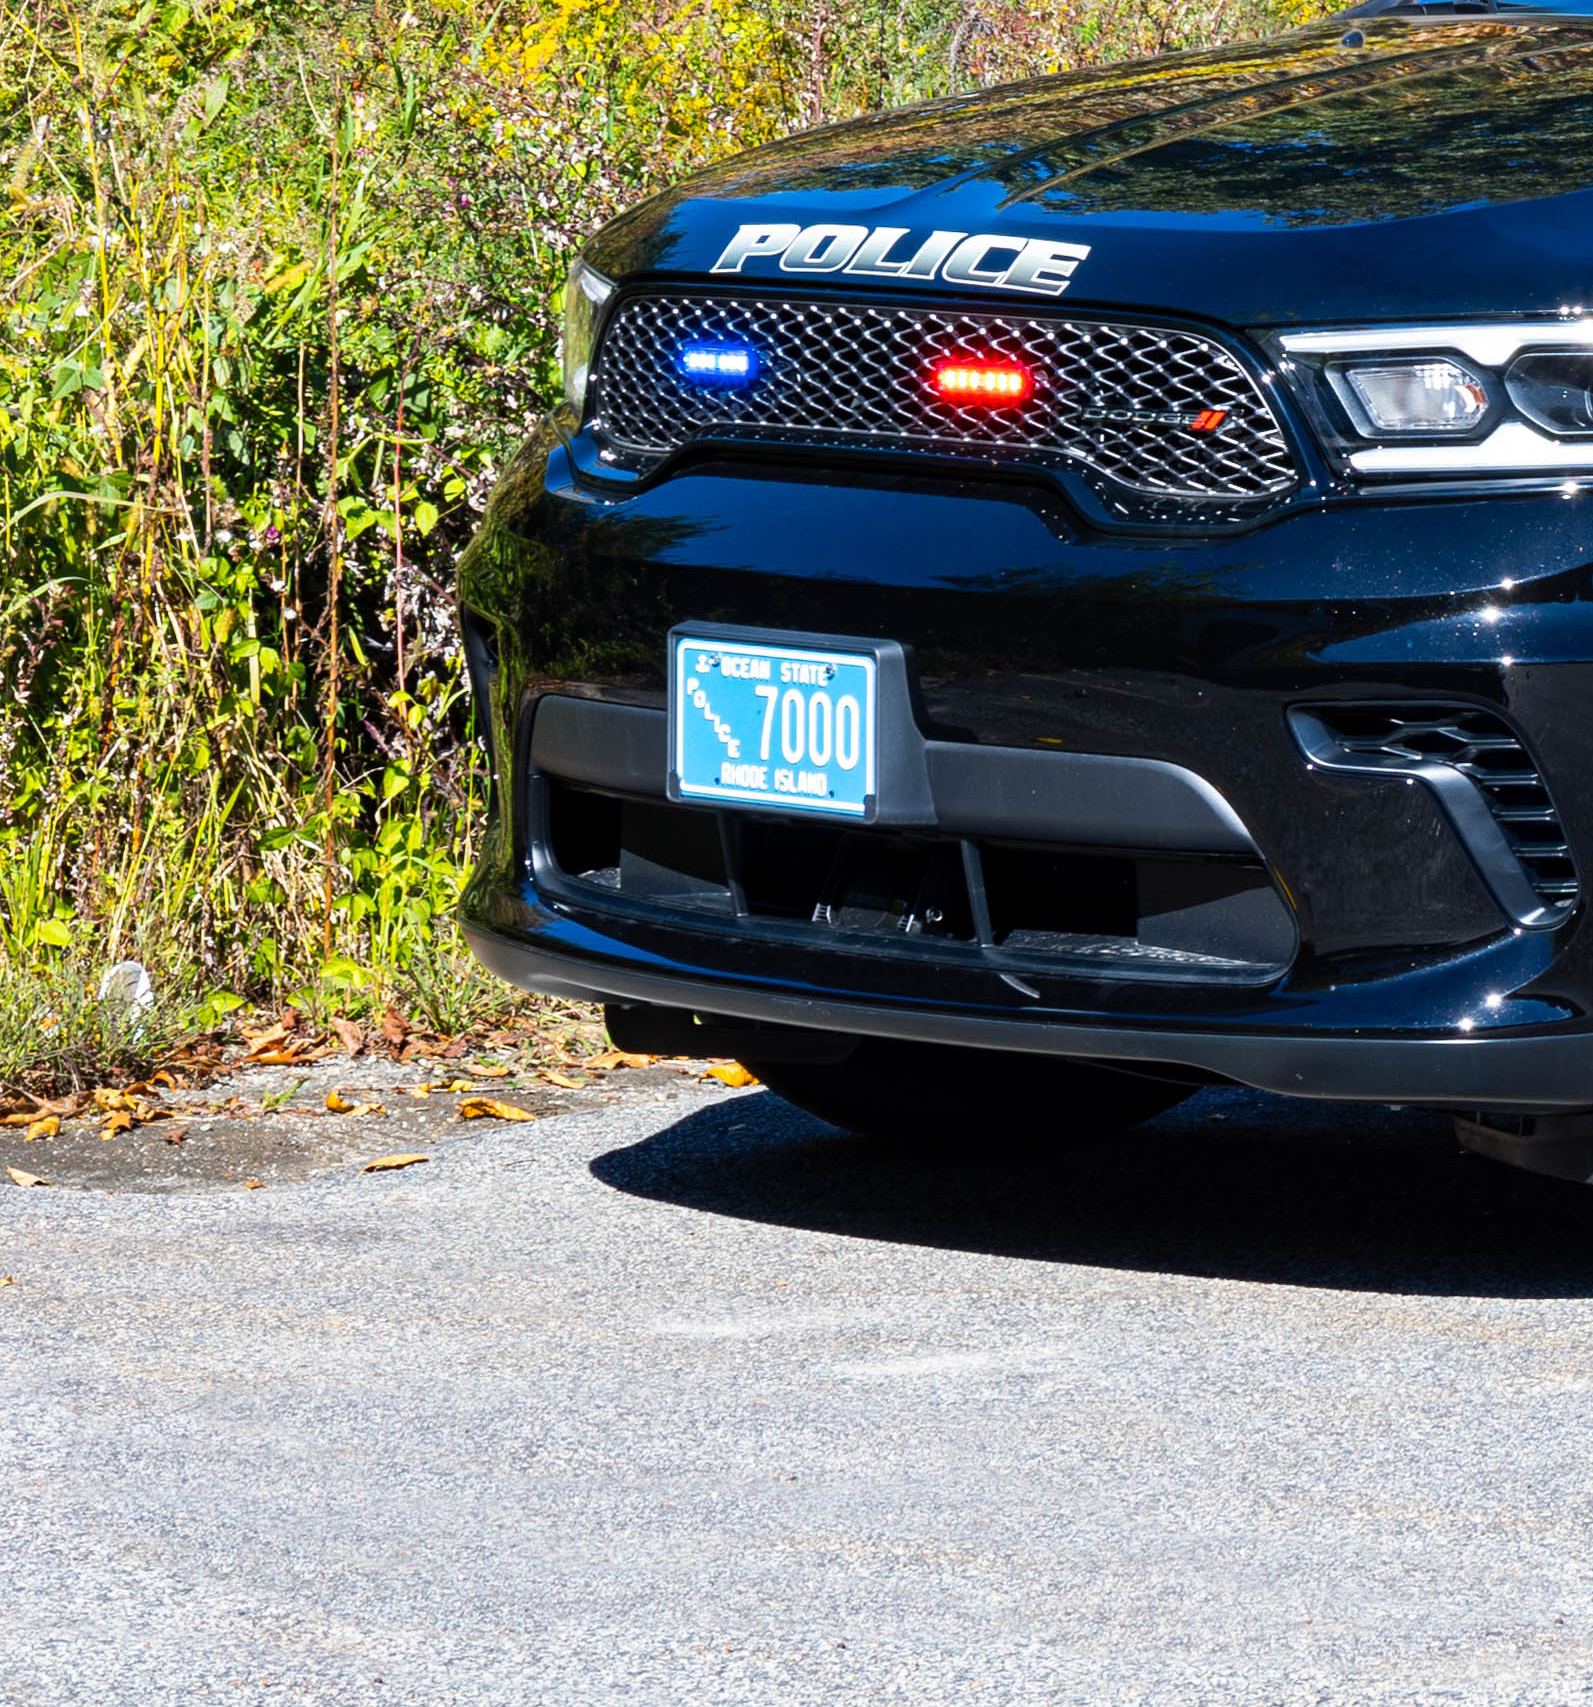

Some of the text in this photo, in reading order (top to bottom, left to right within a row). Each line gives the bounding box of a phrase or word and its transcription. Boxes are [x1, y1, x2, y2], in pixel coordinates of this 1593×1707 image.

[709, 223, 1092, 296] POLICE
[720, 656, 830, 687] OCEAN STATE
[686, 676, 741, 759] POLICE
[754, 684, 861, 771] 7000
[720, 762, 828, 797] RHODE ISLAND
